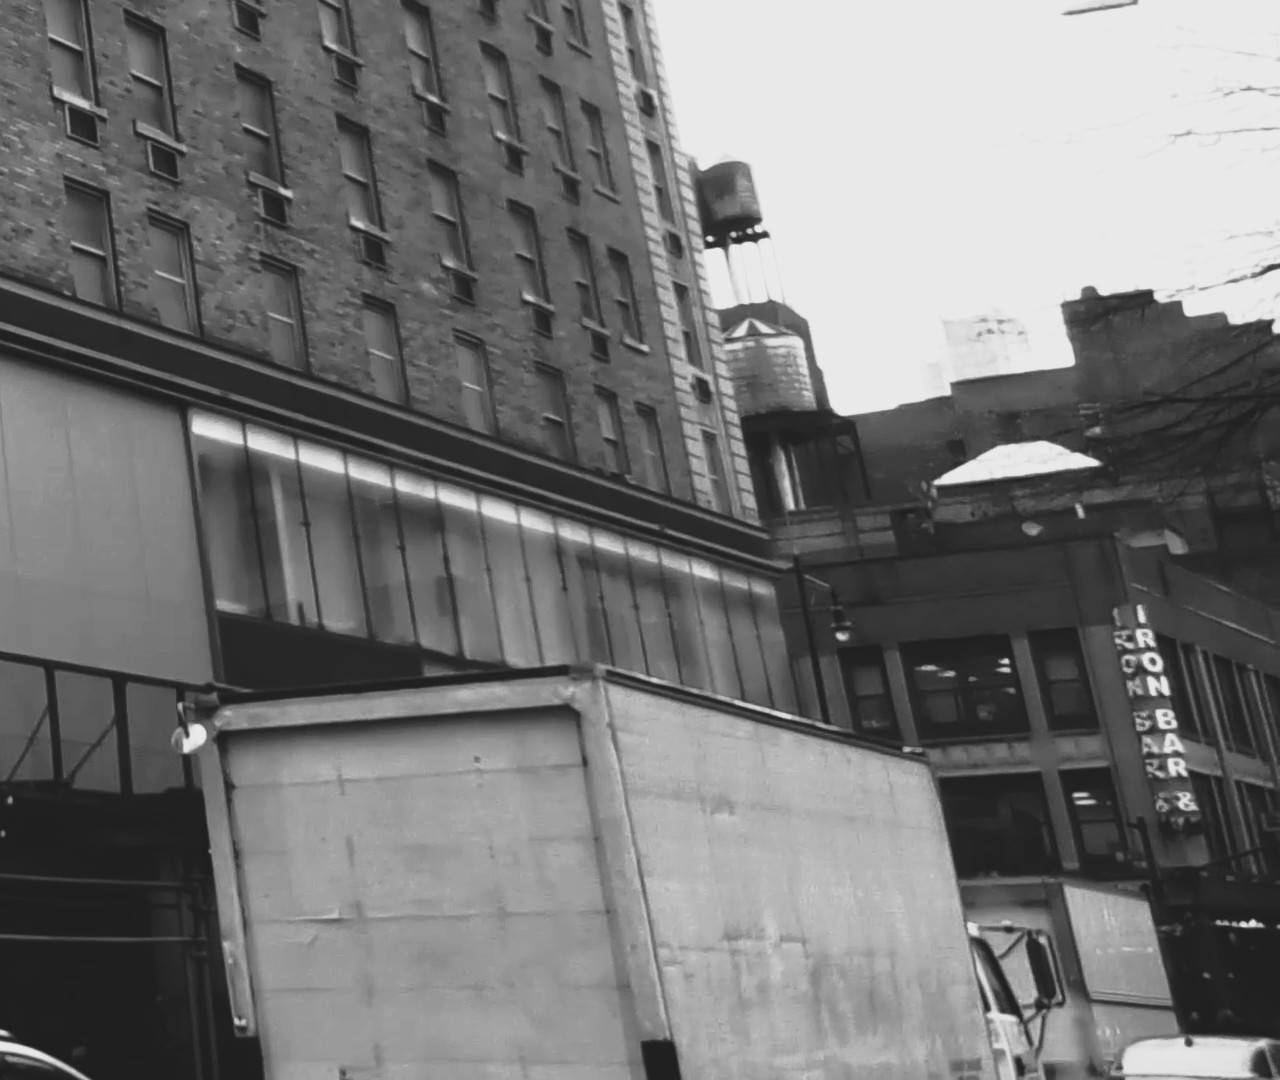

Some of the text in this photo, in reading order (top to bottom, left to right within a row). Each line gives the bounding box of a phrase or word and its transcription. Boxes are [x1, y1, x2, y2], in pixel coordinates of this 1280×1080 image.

[1135, 604, 1200, 812] IRON BAR &
